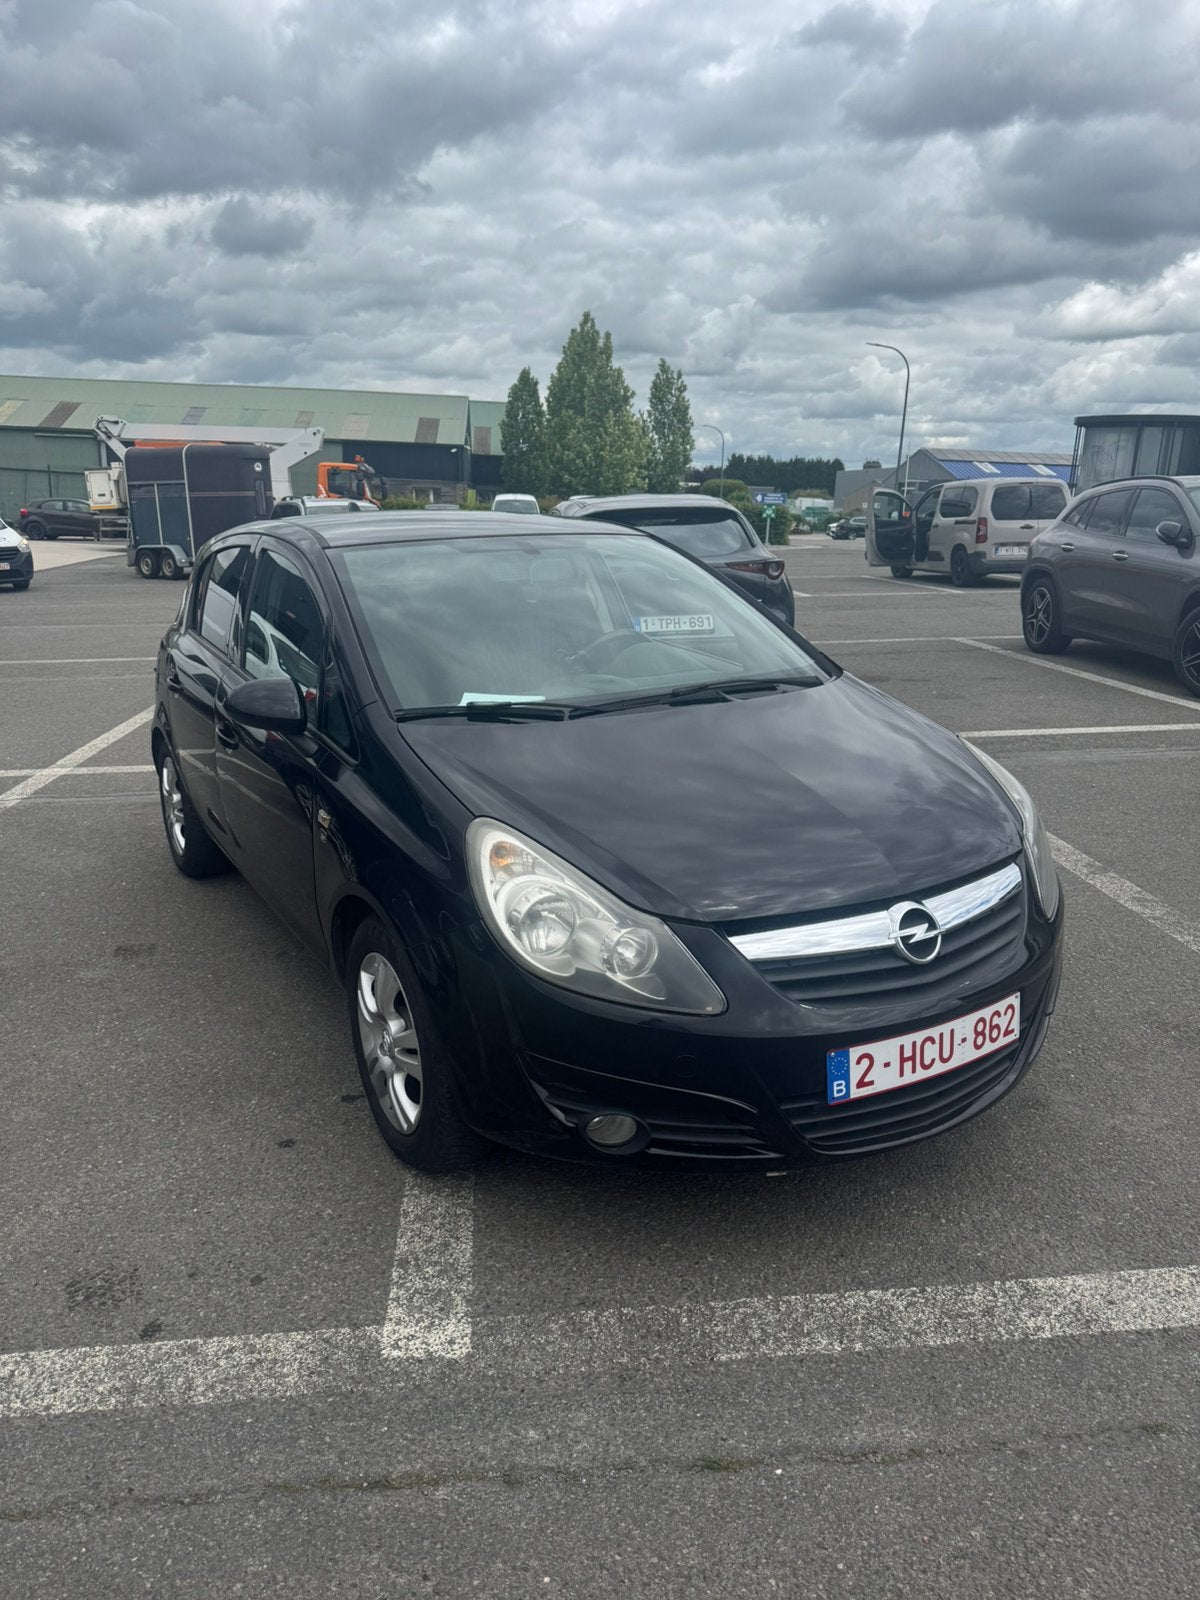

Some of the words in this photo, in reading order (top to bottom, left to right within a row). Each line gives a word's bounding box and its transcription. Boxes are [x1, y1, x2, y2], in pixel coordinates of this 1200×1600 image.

[643, 616, 711, 631] 1-TPH-691
[833, 1080, 846, 1098] B
[855, 1003, 1016, 1090] 2-HCU-862
